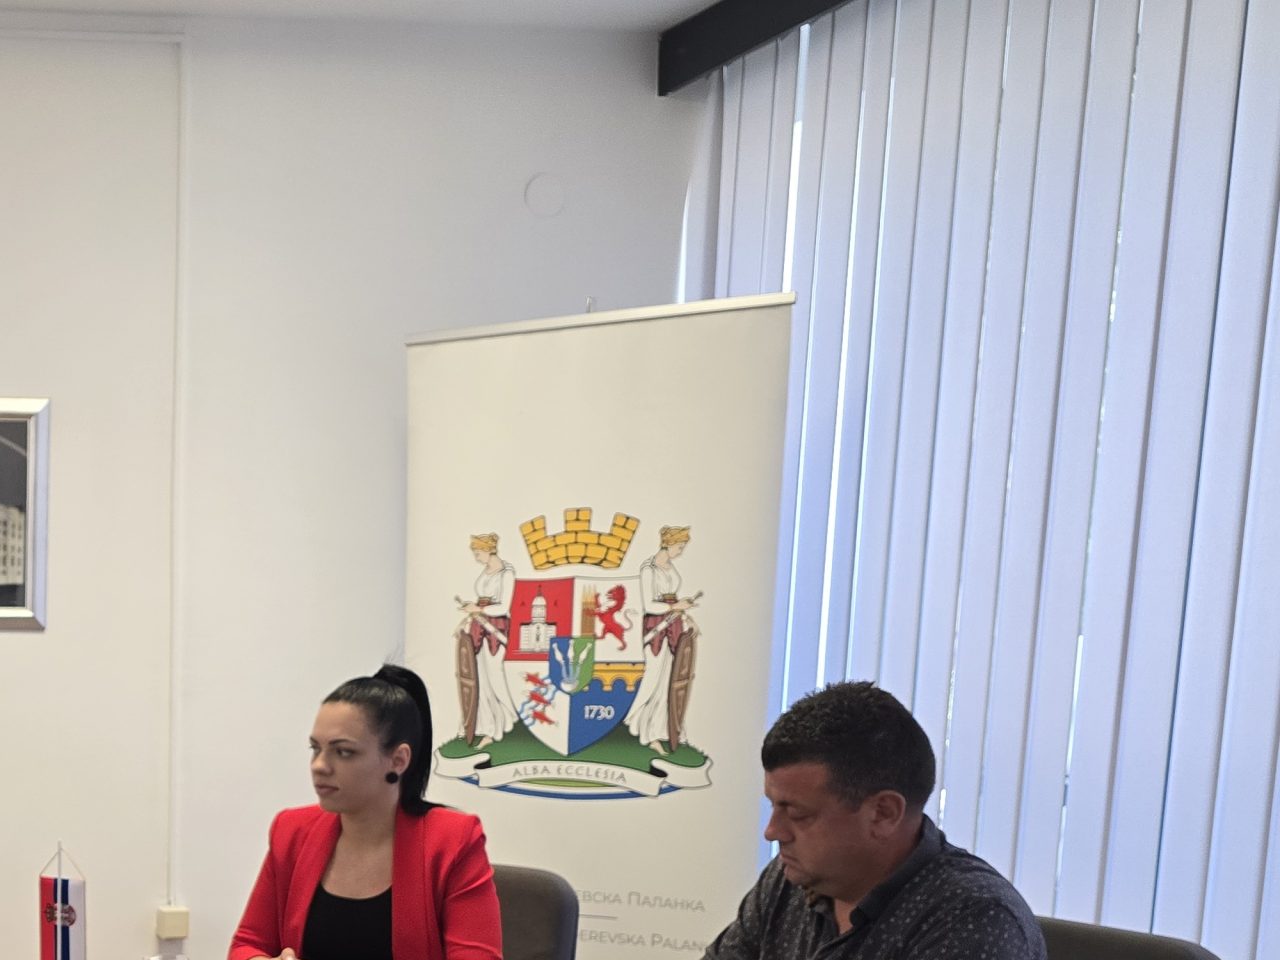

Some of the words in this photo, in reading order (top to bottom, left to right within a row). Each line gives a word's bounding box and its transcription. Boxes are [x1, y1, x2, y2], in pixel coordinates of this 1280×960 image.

[583, 705, 616, 721] 1730
[512, 765, 551, 778] ALBA
[556, 765, 628, 783] ECCLESIA
[628, 890, 706, 912] ПАЛАНКА
